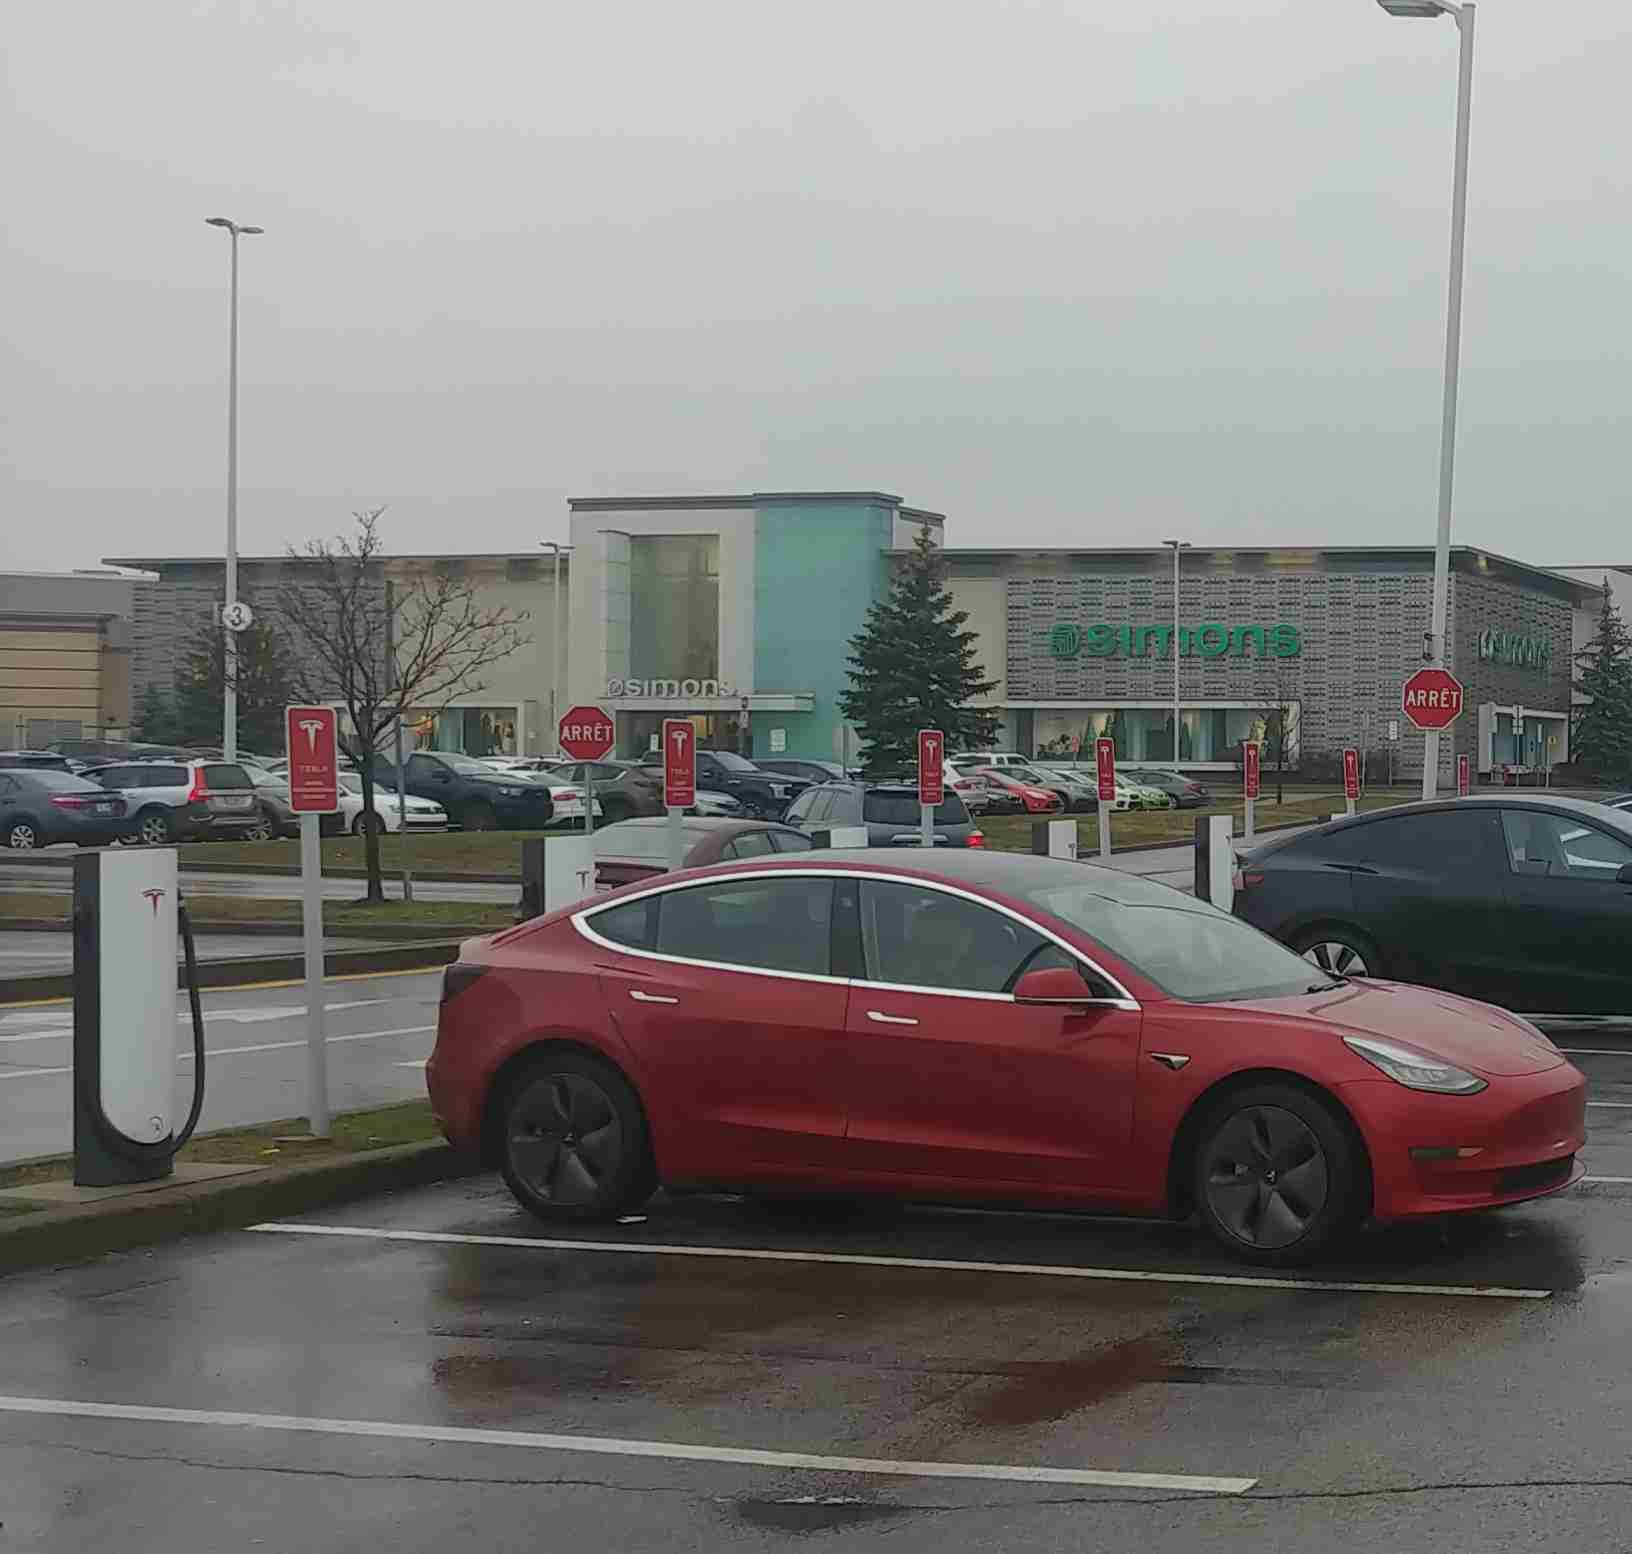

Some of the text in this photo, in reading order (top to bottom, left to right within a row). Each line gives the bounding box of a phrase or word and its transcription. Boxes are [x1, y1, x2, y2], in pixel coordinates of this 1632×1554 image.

[1087, 624, 1301, 658] simons
[1405, 688, 1460, 708] ARRÊT
[561, 722, 612, 741] ARRÊT
